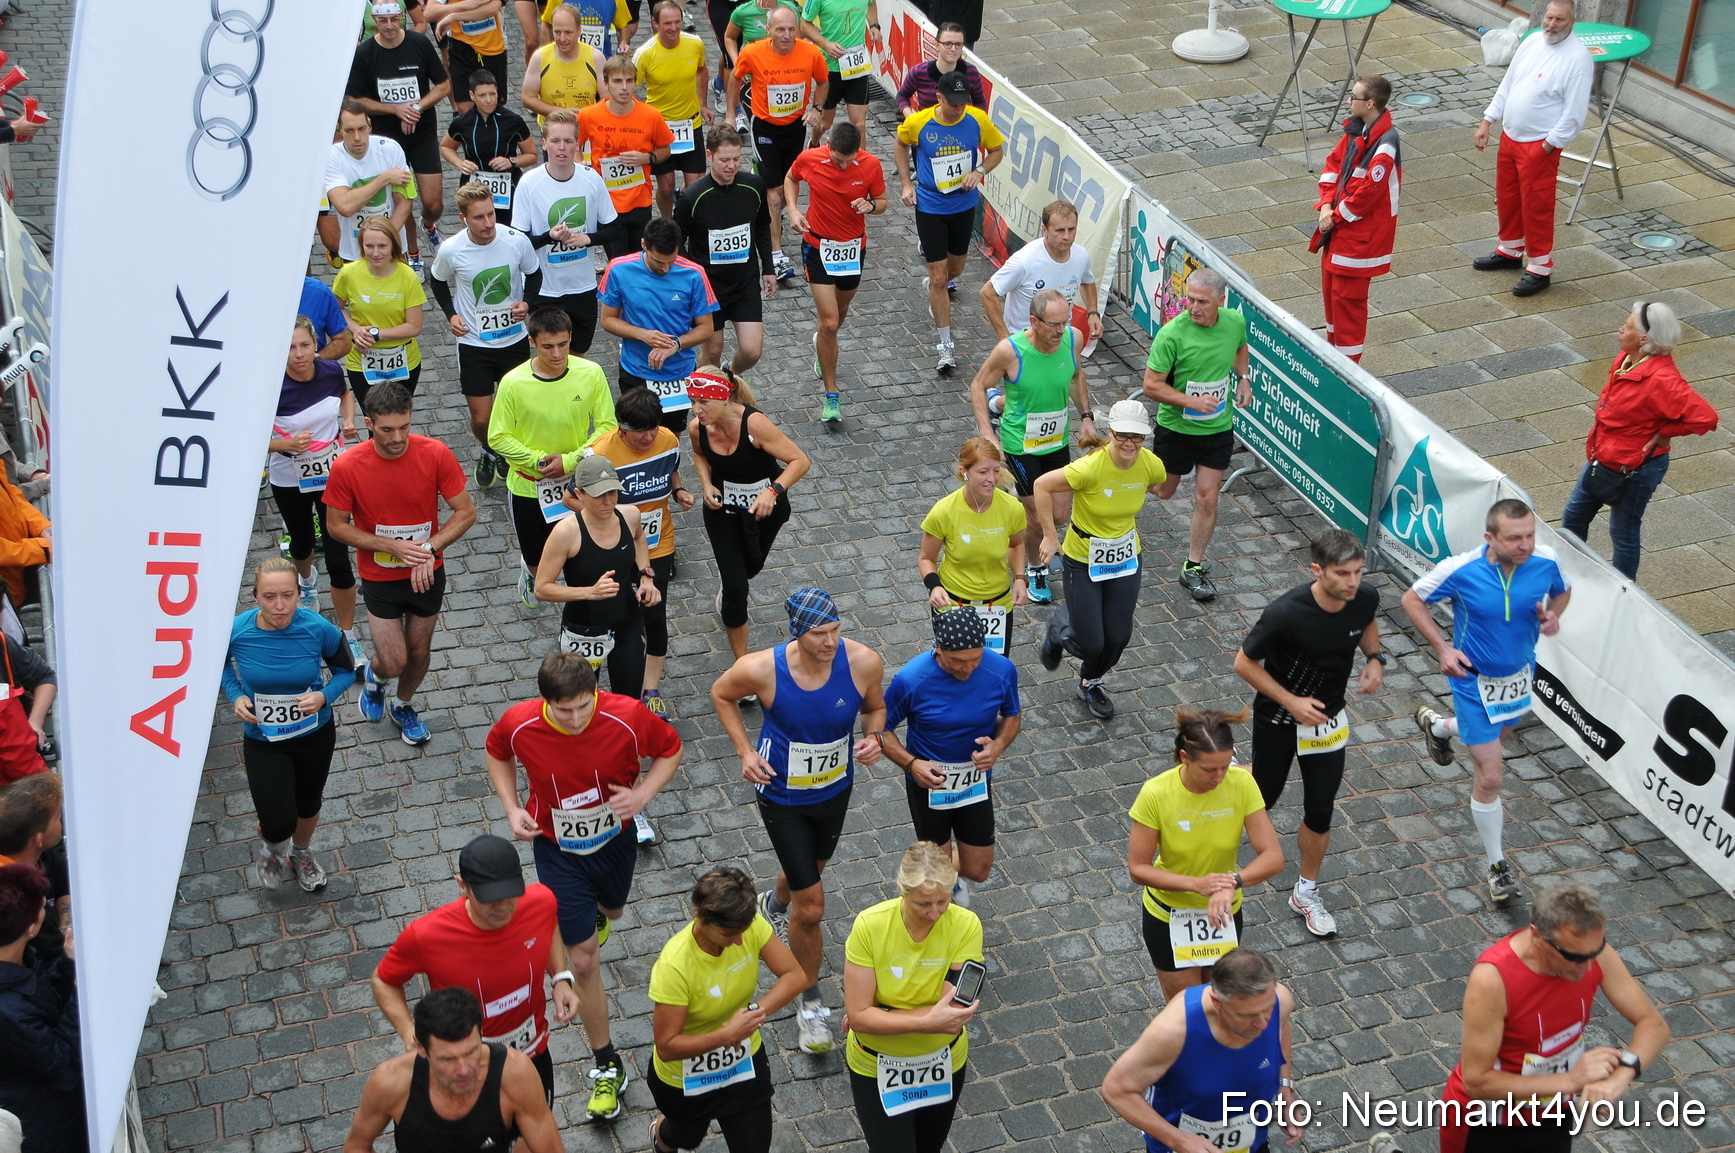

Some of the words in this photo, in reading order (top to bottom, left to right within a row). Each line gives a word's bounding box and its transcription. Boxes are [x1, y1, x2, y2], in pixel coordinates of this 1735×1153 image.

[579, 33, 601, 46] 673
[845, 52, 864, 67] 186
[383, 86, 416, 101] 2596
[776, 92, 799, 105] 328
[946, 163, 963, 178] 44
[713, 233, 748, 252] 2395
[717, 251, 746, 261] Sebastian
[824, 247, 857, 262] 2830
[491, 330, 511, 339] Daniel
[367, 354, 404, 371] 2148
[1250, 321, 1320, 388] Event-Leit-Systeme
[154, 283, 230, 489] BKK
[1261, 371, 1321, 438] Sicherheit
[1039, 420, 1057, 437] 99
[1264, 402, 1302, 451] Event!
[1248, 426, 1273, 458] Service
[1274, 451, 1291, 474] Line:
[1292, 467, 1315, 495] 09181
[1316, 488, 1335, 514] 6352
[629, 472, 670, 492] Fischer
[641, 520, 658, 535] 76
[1094, 543, 1133, 564] 2653
[129, 531, 202, 758] Audi
[569, 641, 604, 658] 236
[1537, 678, 1554, 698] die
[1555, 692, 1607, 749] verbinden
[277, 725, 301, 734] Maria
[1310, 734, 1342, 748] Christian
[803, 751, 839, 774] 178
[811, 774, 829, 784] Uwe
[561, 813, 616, 838] 2674
[1183, 918, 1224, 942] 132
[1191, 947, 1221, 958] Andrea
[878, 1057, 903, 1067] PARTL
[905, 1055, 940, 1067] Neumarkt
[885, 1063, 945, 1088] 2076
[901, 1088, 929, 1102] Sonja
